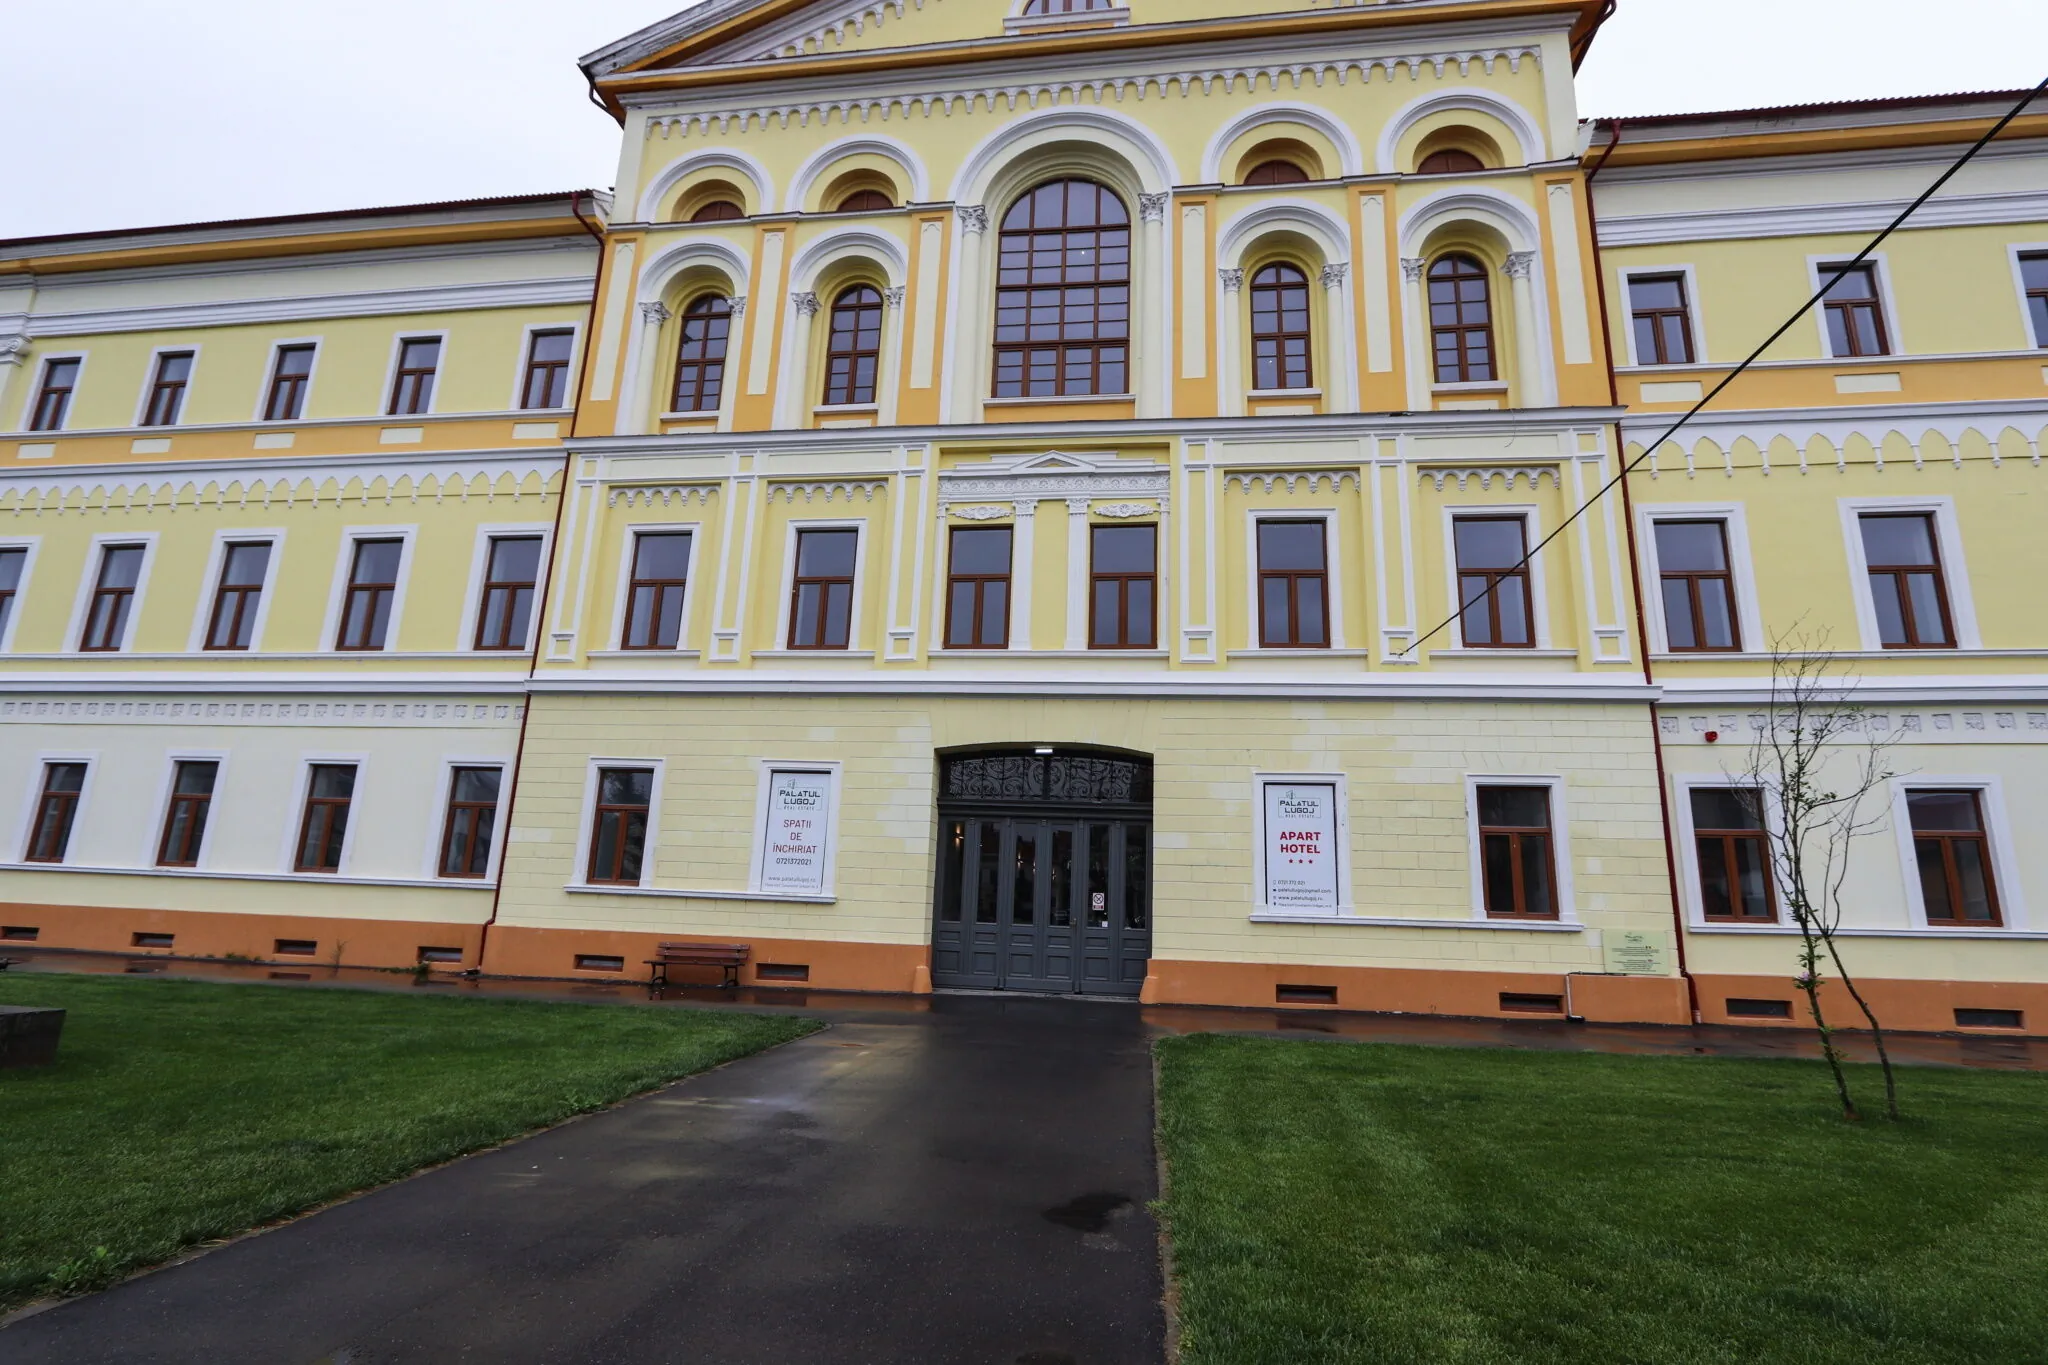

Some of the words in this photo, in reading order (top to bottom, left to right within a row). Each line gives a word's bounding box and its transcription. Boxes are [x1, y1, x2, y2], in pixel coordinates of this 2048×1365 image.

[790, 832, 802, 840] DE
[1280, 831, 1321, 841] APART
[1280, 844, 1321, 854] HOTEL
